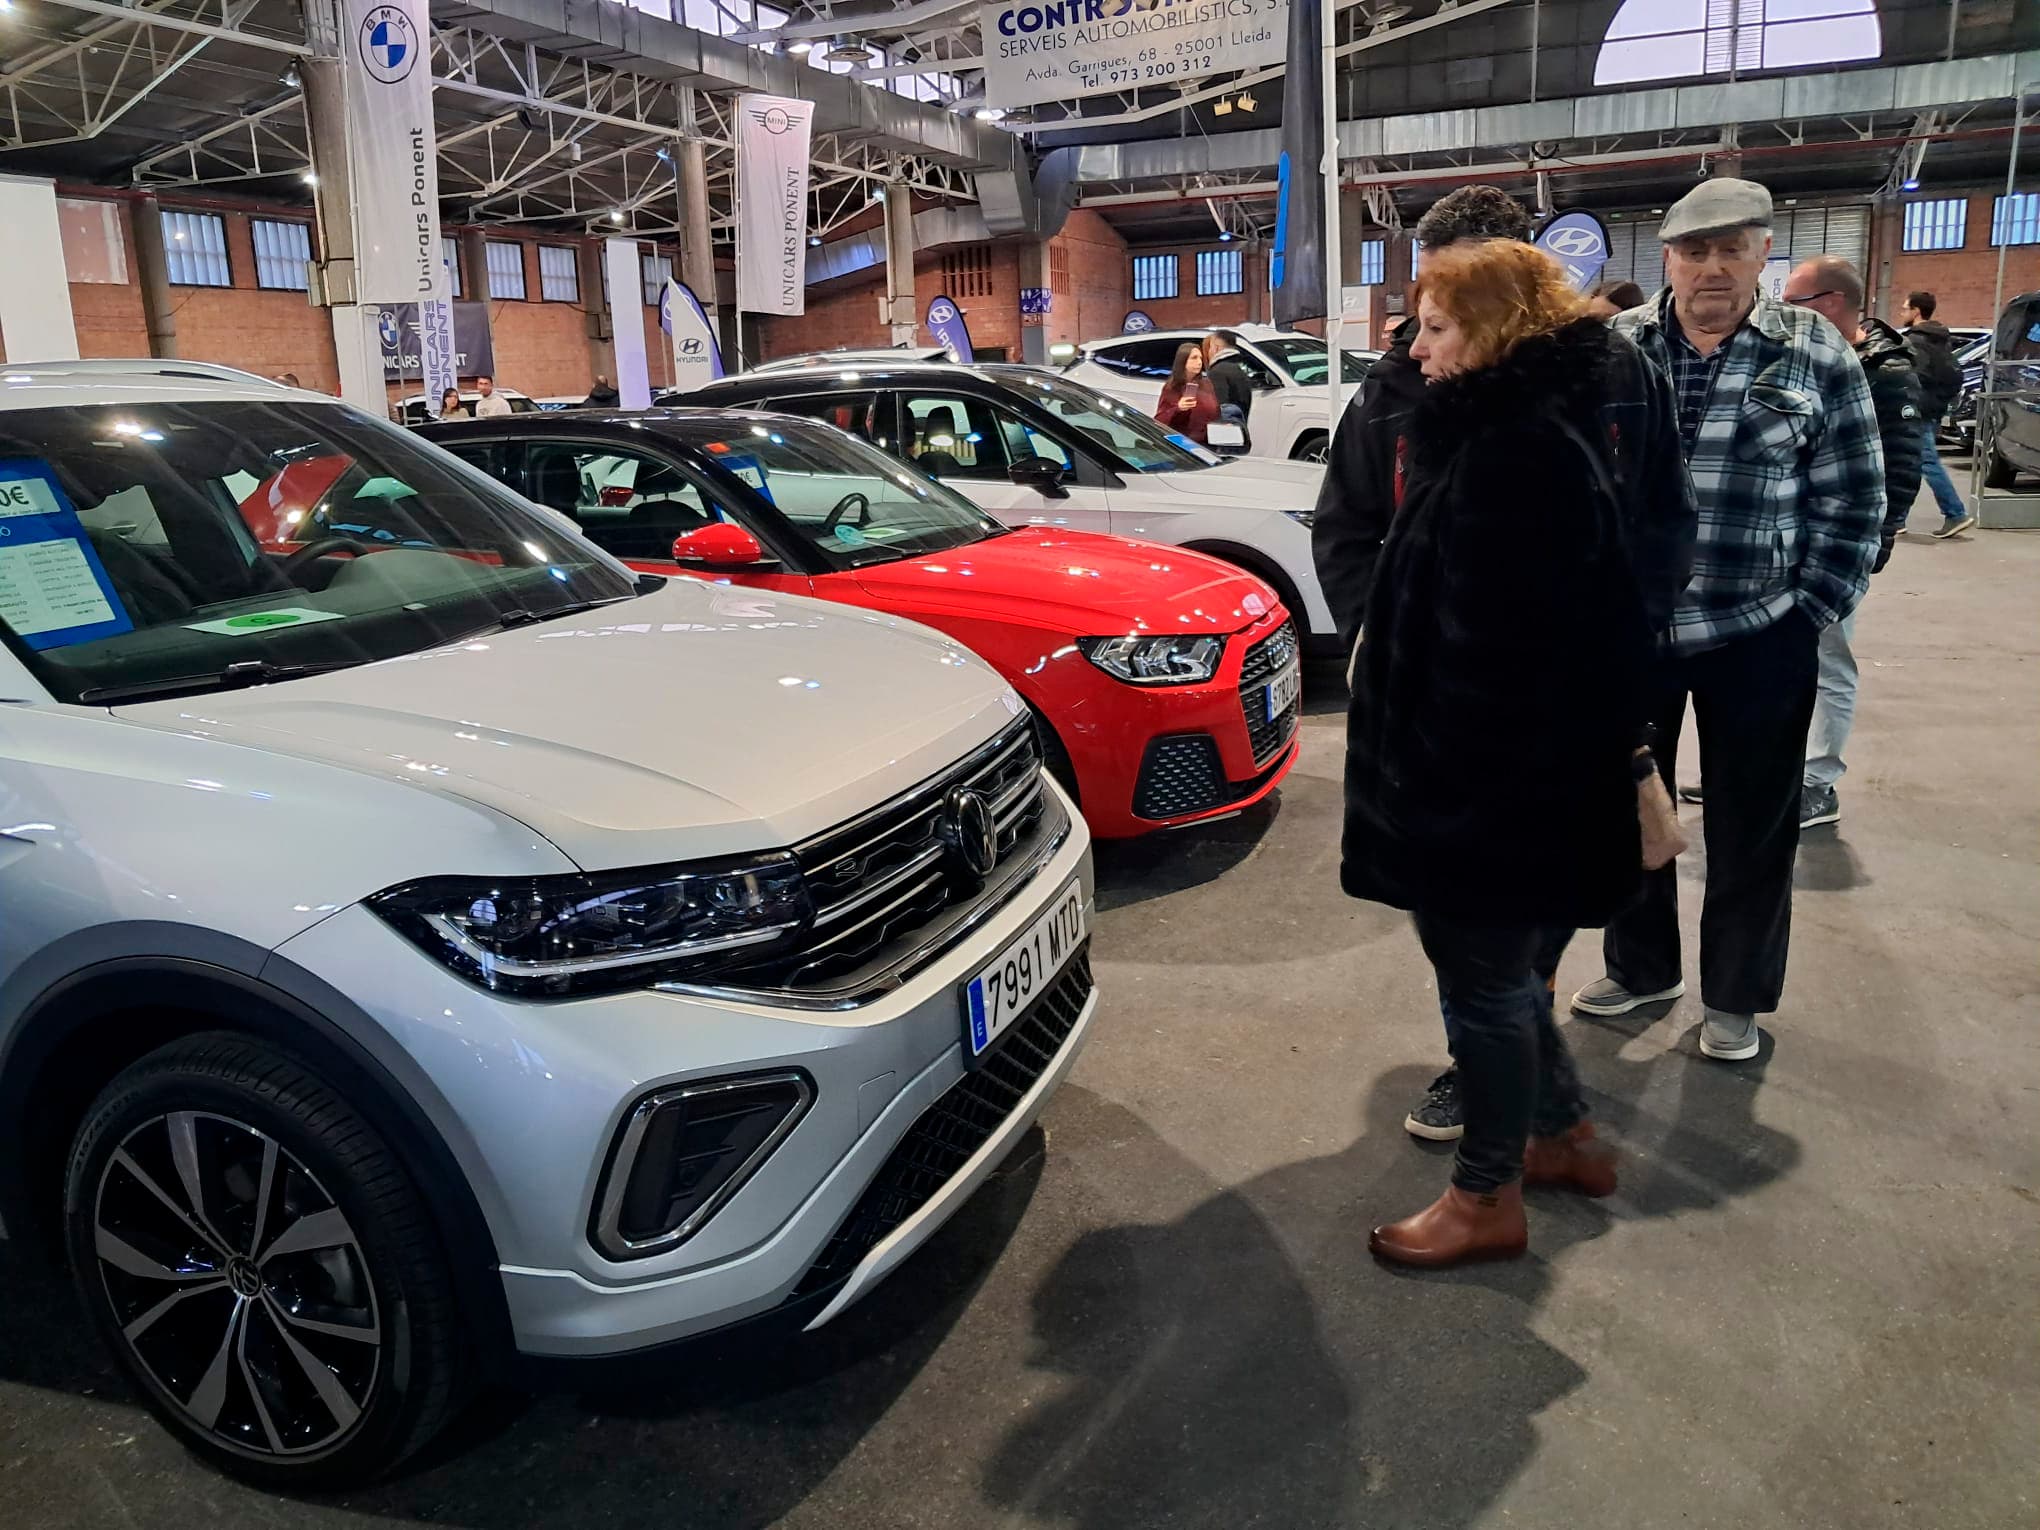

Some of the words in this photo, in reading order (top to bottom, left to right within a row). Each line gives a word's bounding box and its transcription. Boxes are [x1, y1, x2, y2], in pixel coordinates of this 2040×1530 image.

[365, 9, 408, 31] BMW
[1000, 32, 1067, 58] SERVEIS
[1074, 0, 1258, 46] AUTOMOBILISTICS,
[1069, 56, 1132, 74] Garrigues,
[1139, 47, 1157, 62] 68
[1175, 36, 1223, 56] 25001
[1231, 26, 1272, 46] Lleida
[1081, 73, 1104, 89] Tel.
[1110, 68, 1139, 83] 973
[1146, 62, 1175, 78] 200
[1182, 56, 1211, 72] 312
[766, 116, 786, 126] MINI
[410, 127, 425, 207] Ponent
[784, 166, 800, 233] PONENT
[783, 235, 797, 307] UNICARS
[436, 299, 453, 390] ONENT
[988, 934, 1043, 1029] 7991
[1048, 895, 1080, 966] MTD
